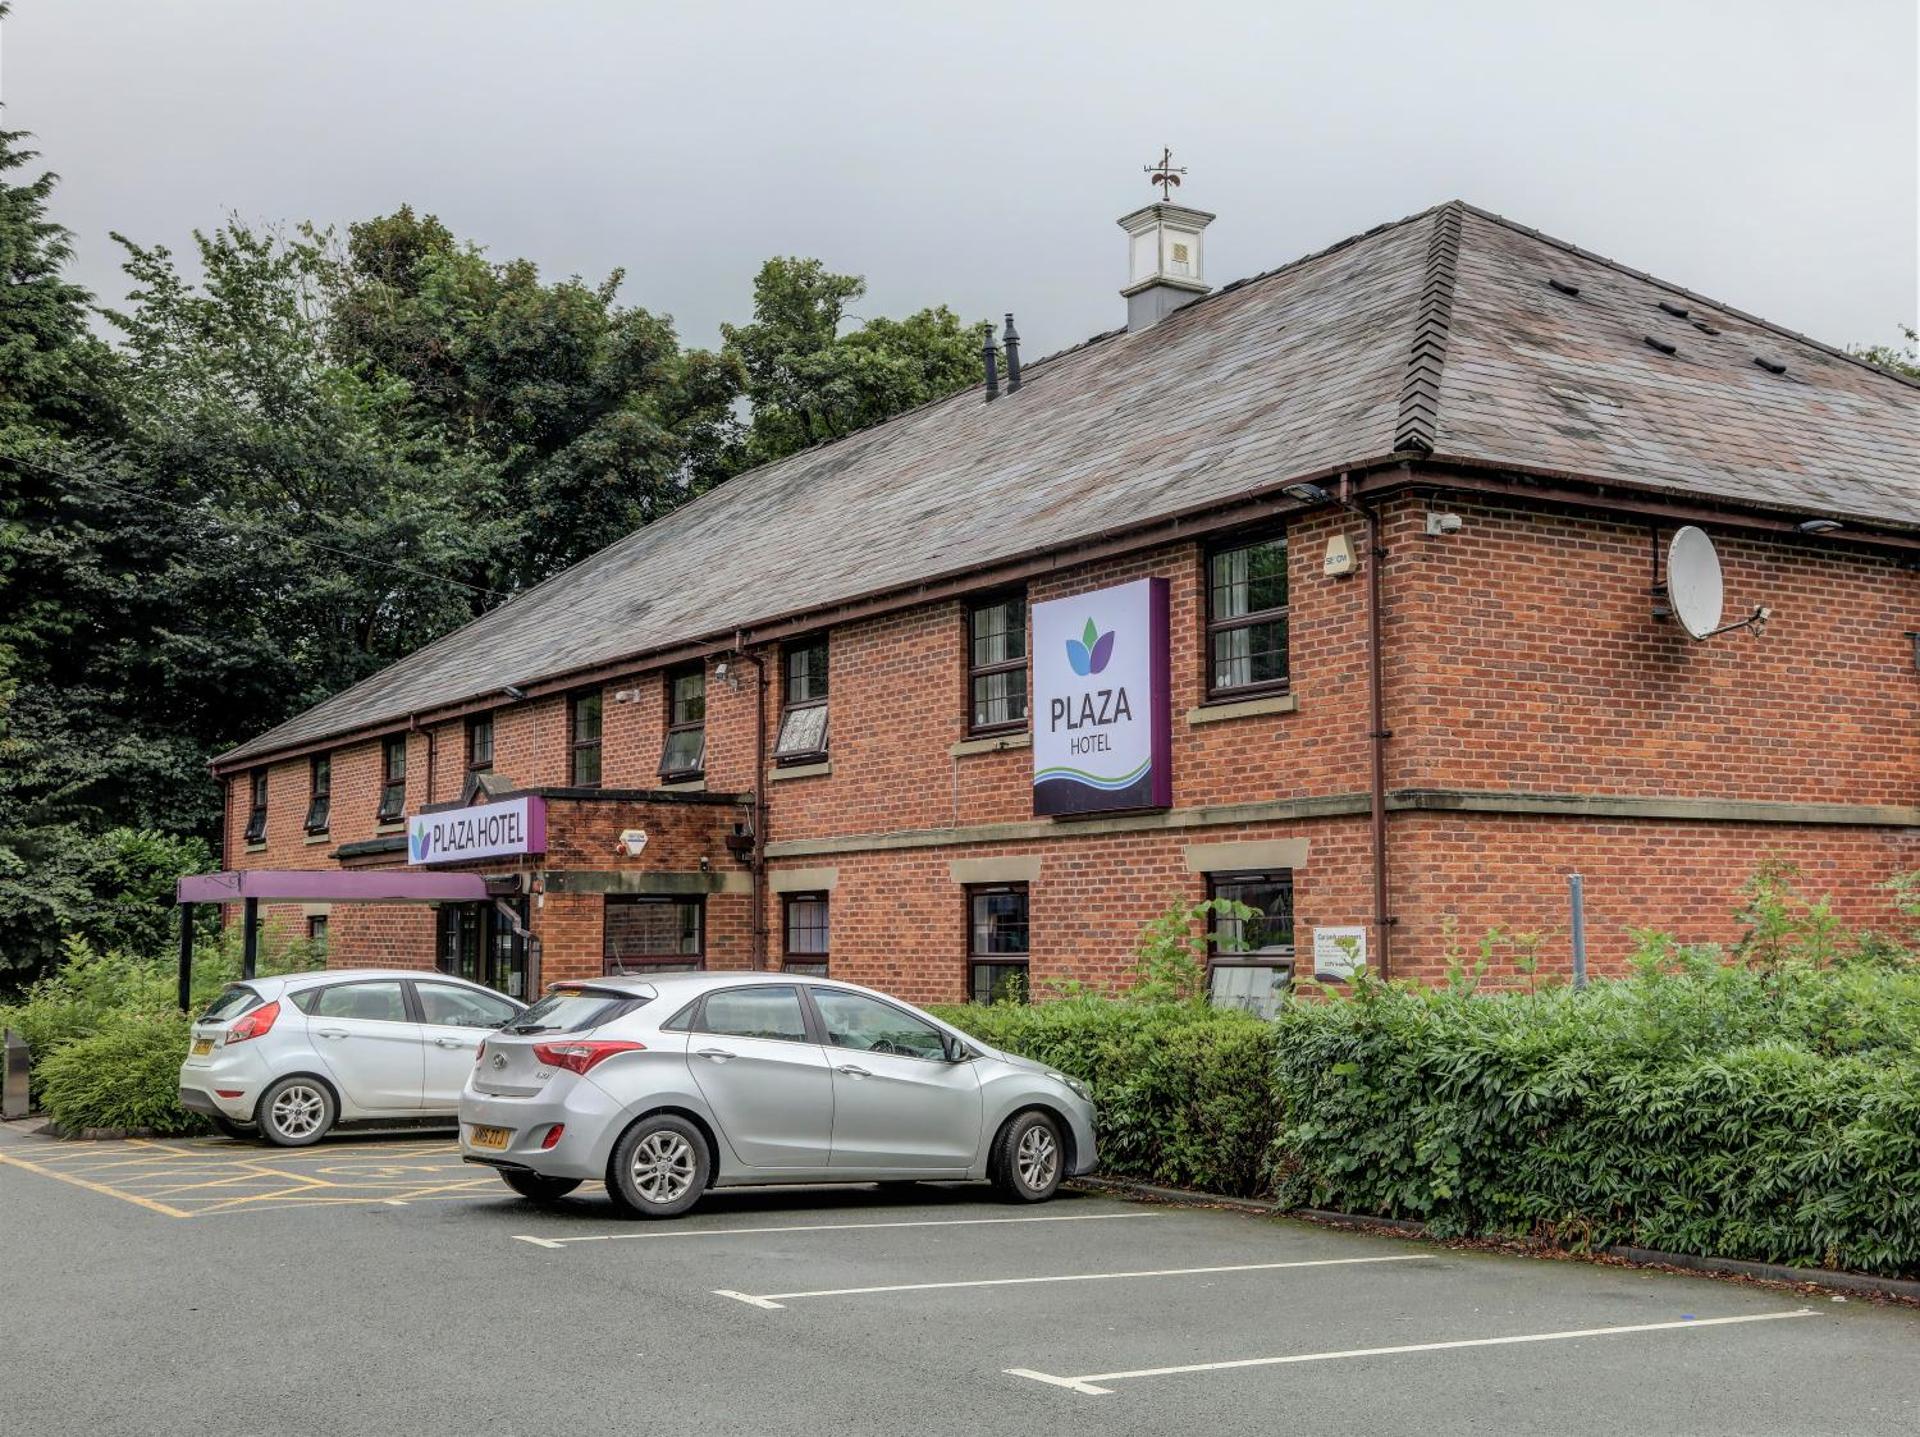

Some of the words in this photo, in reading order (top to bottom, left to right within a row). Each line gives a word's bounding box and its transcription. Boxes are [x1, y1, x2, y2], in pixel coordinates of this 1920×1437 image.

[1051, 686, 1133, 732] PLAZA
[1070, 732, 1112, 755] HOTEL
[433, 819, 475, 853] PLAZA
[478, 811, 524, 847] HOTEL
